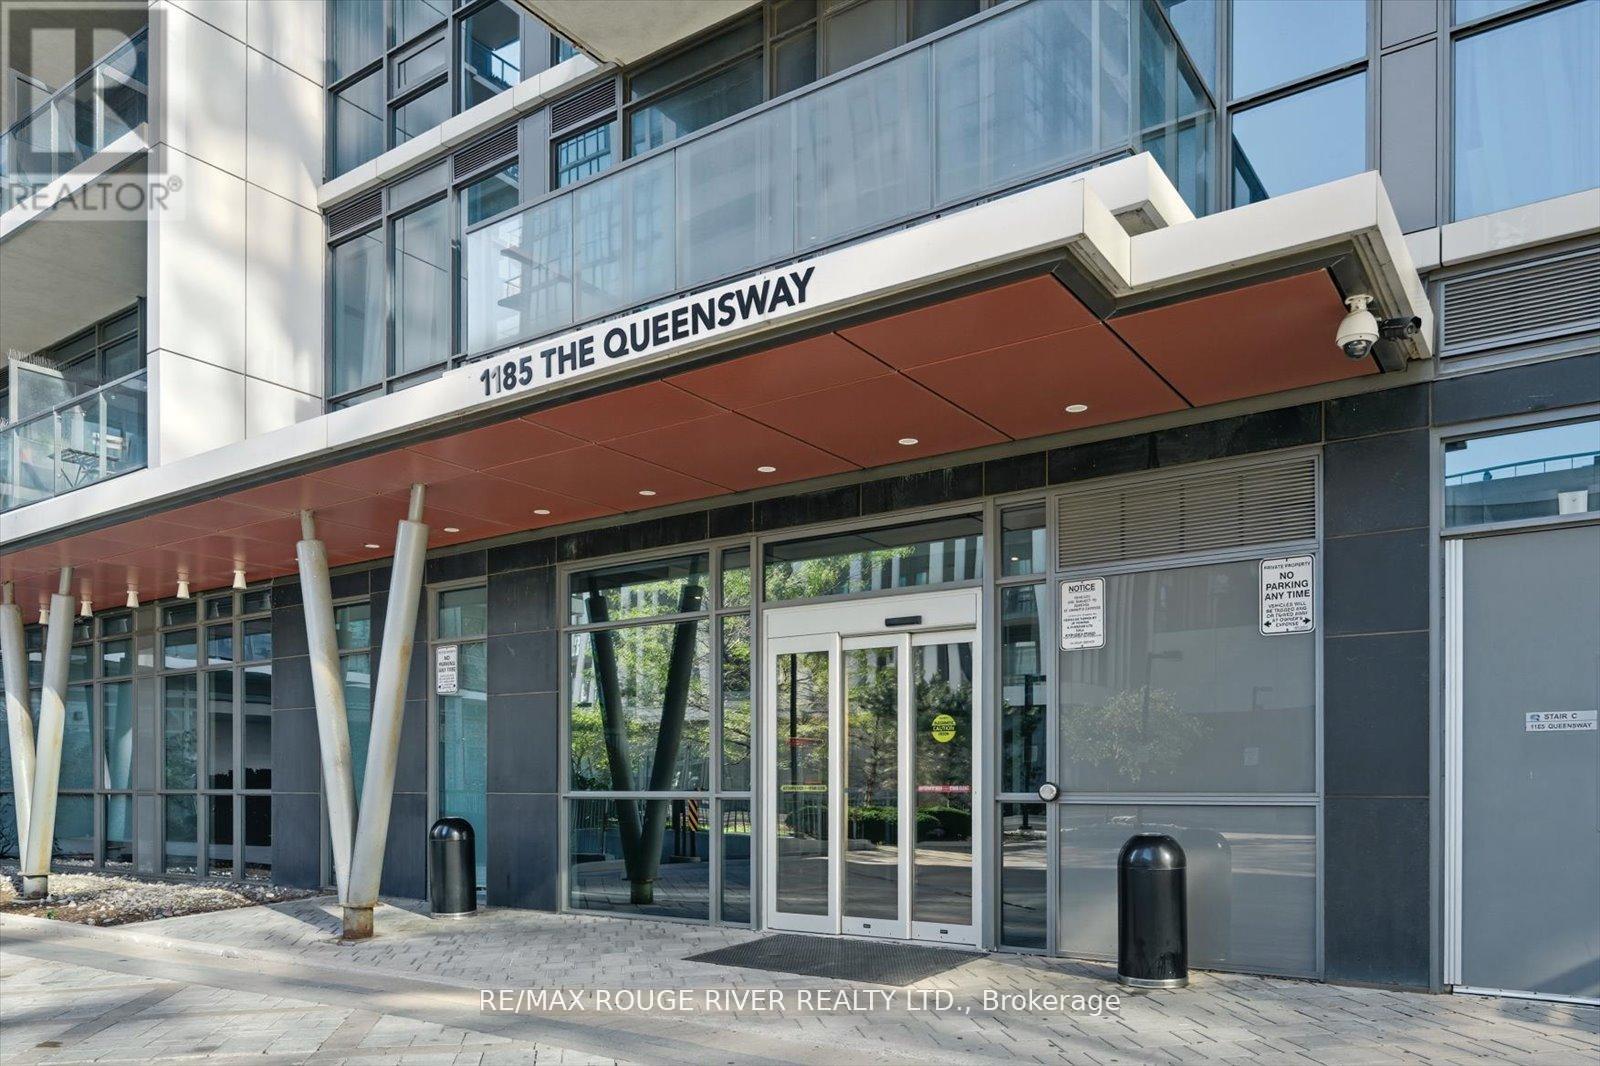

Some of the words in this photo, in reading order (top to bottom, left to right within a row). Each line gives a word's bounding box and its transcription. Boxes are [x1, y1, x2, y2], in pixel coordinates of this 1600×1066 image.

[480, 356, 533, 396] 1185
[540, 336, 594, 378] THE
[603, 266, 815, 359] QUEENSWAY
[1280, 571, 1294, 579] NO
[1068, 583, 1095, 592] NOTICE
[1266, 580, 1308, 591] PARKING
[1265, 592, 1284, 600] ANY
[1287, 589, 1310, 598] TIME
